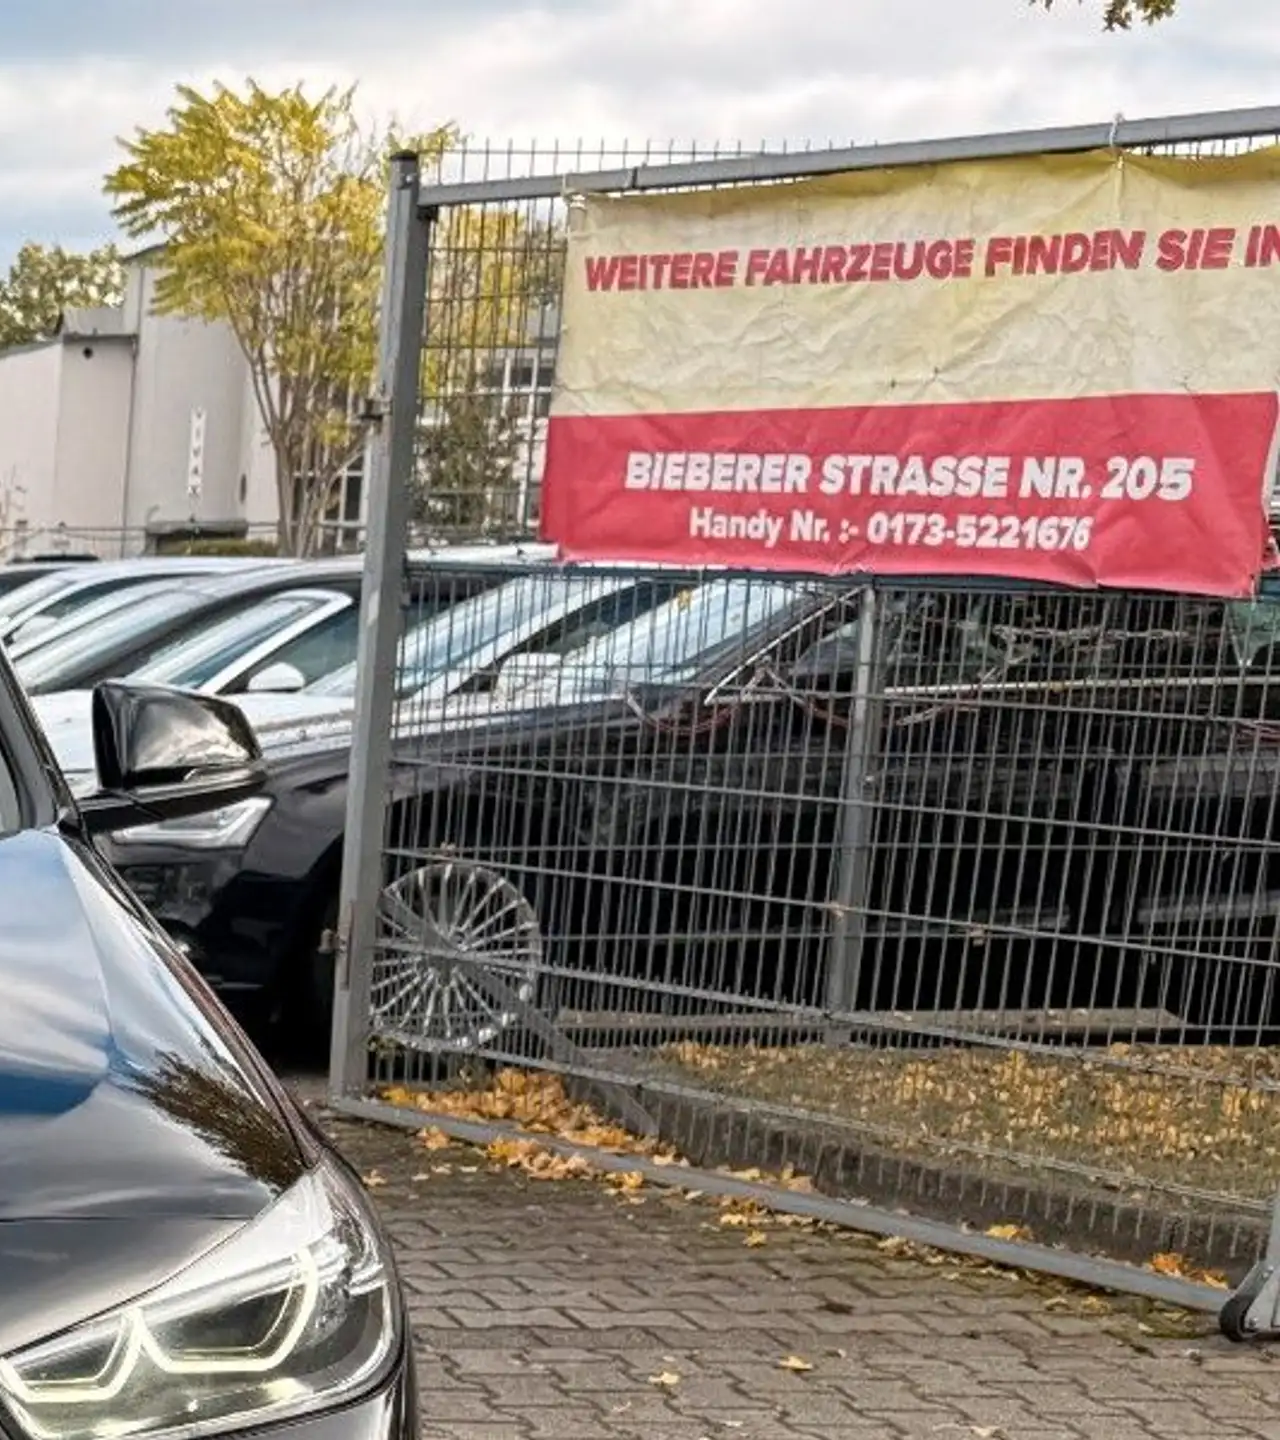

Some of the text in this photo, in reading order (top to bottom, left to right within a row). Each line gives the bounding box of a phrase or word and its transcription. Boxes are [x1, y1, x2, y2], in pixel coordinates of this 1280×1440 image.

[585, 251, 738, 291] WEITERE
[745, 238, 975, 286] FAHRZEUGE
[985, 229, 1146, 277] FINDEN
[1156, 228, 1236, 272] SIE
[625, 452, 1195, 500] BIEBERER STRASSE NR. 205
[690, 507, 783, 547] Handy
[790, 510, 830, 542] Nr.
[867, 511, 1094, 551] 0173-5221676
